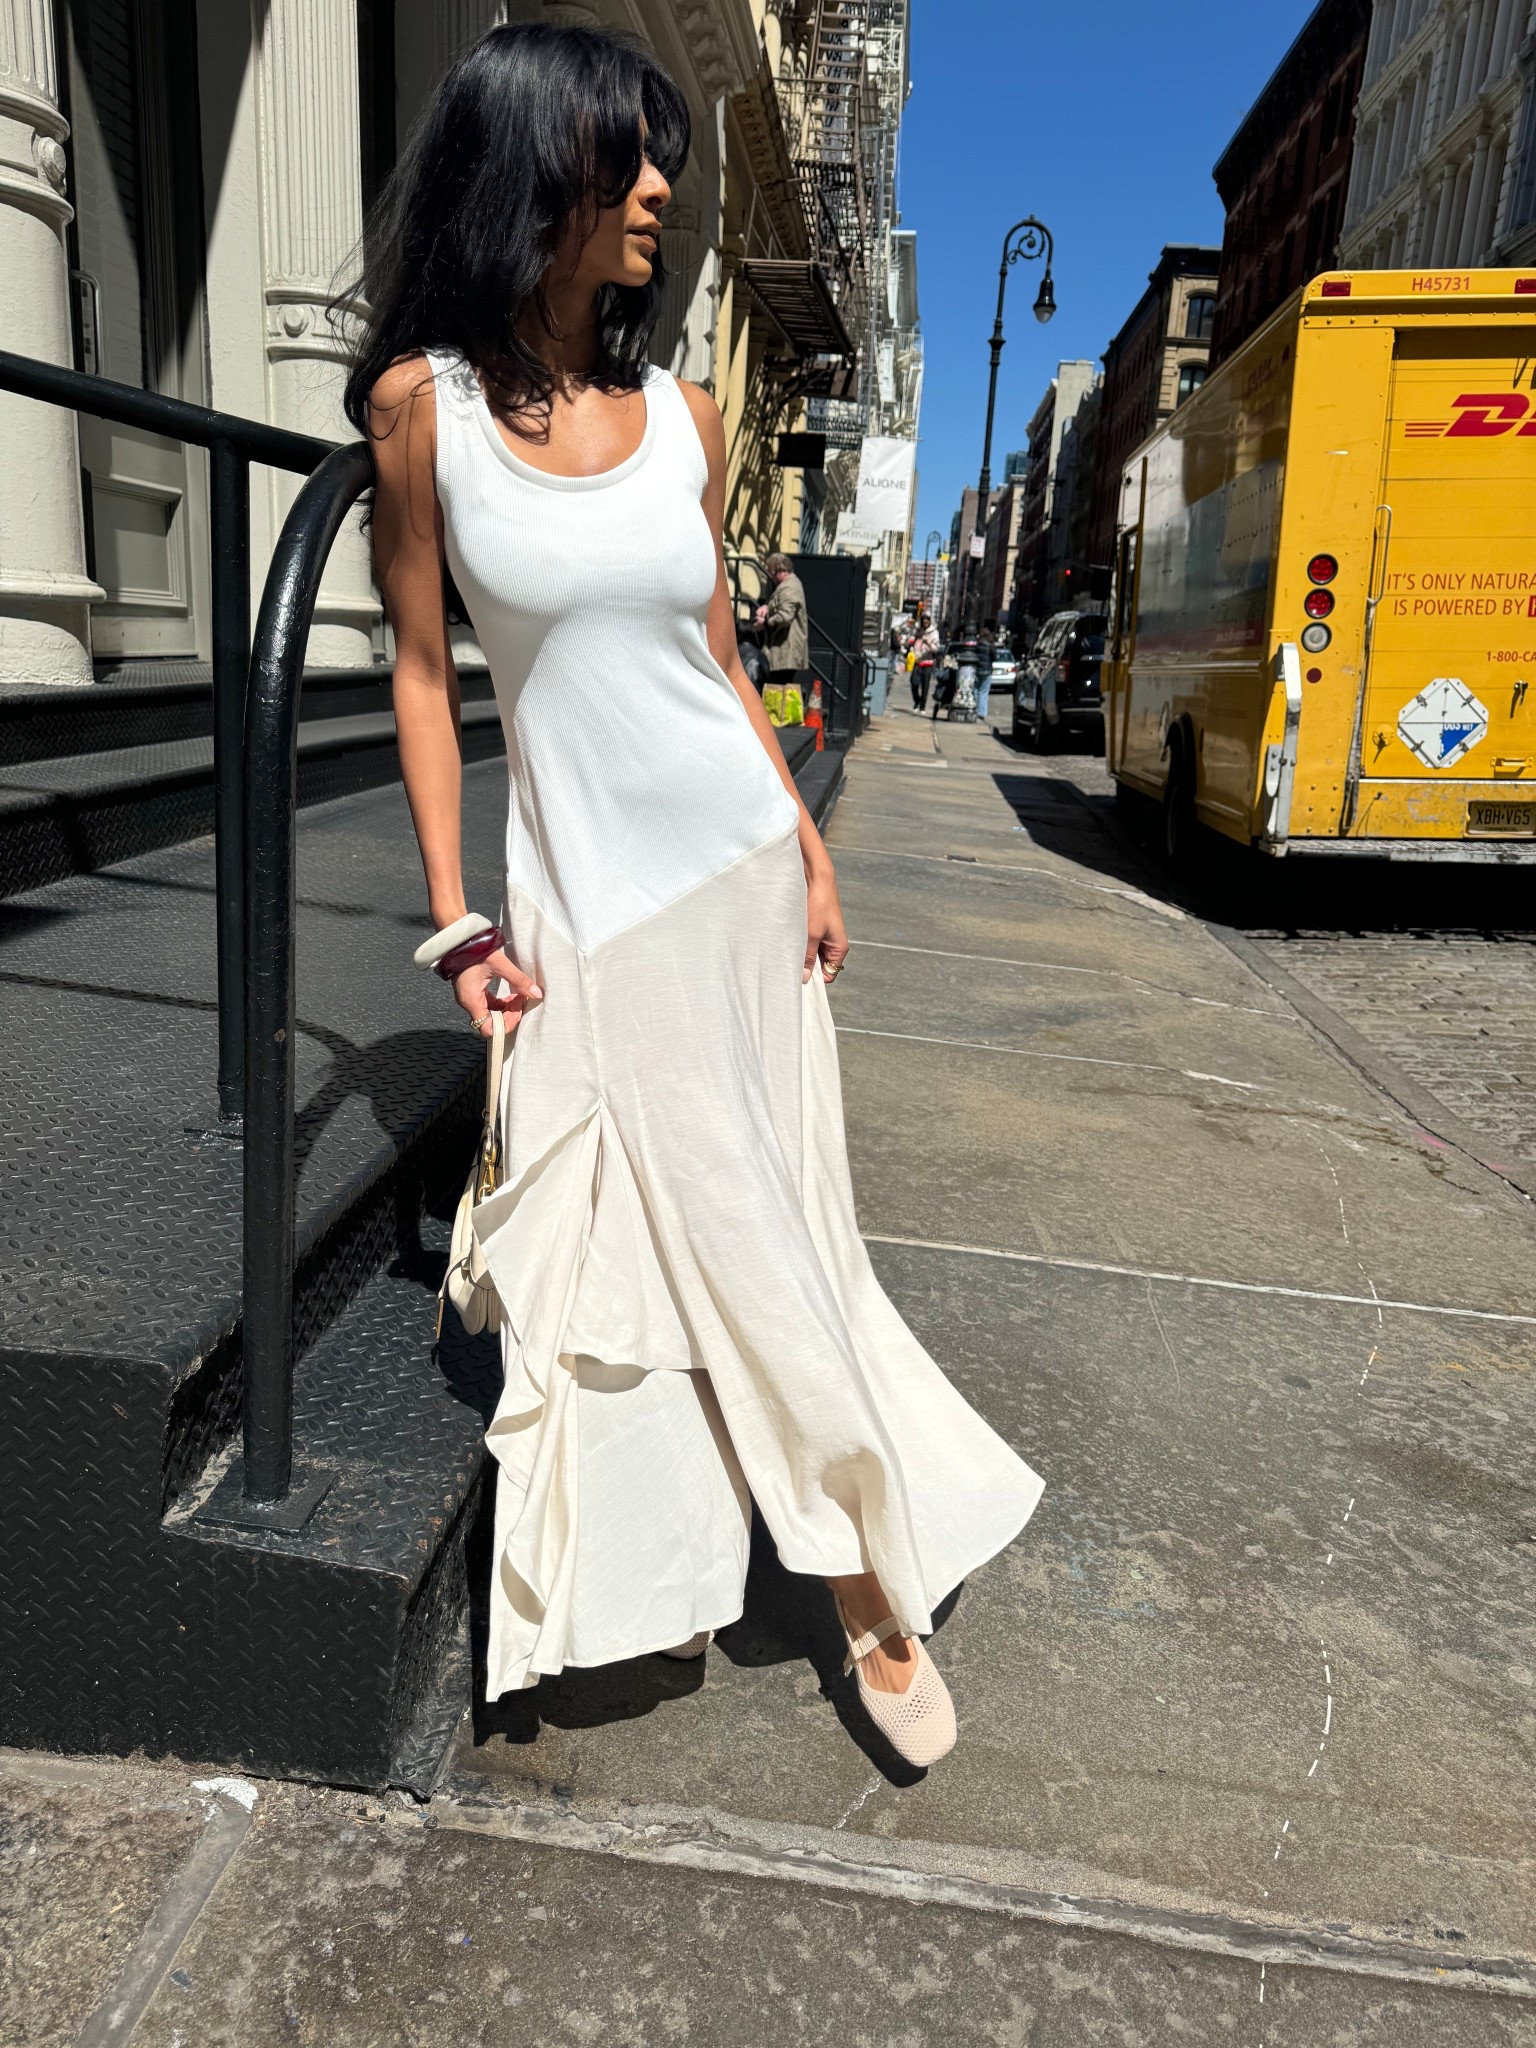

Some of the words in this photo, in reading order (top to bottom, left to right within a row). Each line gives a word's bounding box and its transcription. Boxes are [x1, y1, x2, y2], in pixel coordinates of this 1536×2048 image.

[1412, 277, 1470, 291] H45731
[862, 477, 907, 489] ALIGNE
[1387, 573, 1415, 590] IT'S
[1421, 573, 1466, 590] ONLY
[1393, 599, 1408, 615] IS
[1413, 599, 1497, 615] POWERED
[1502, 599, 1525, 615] BY
